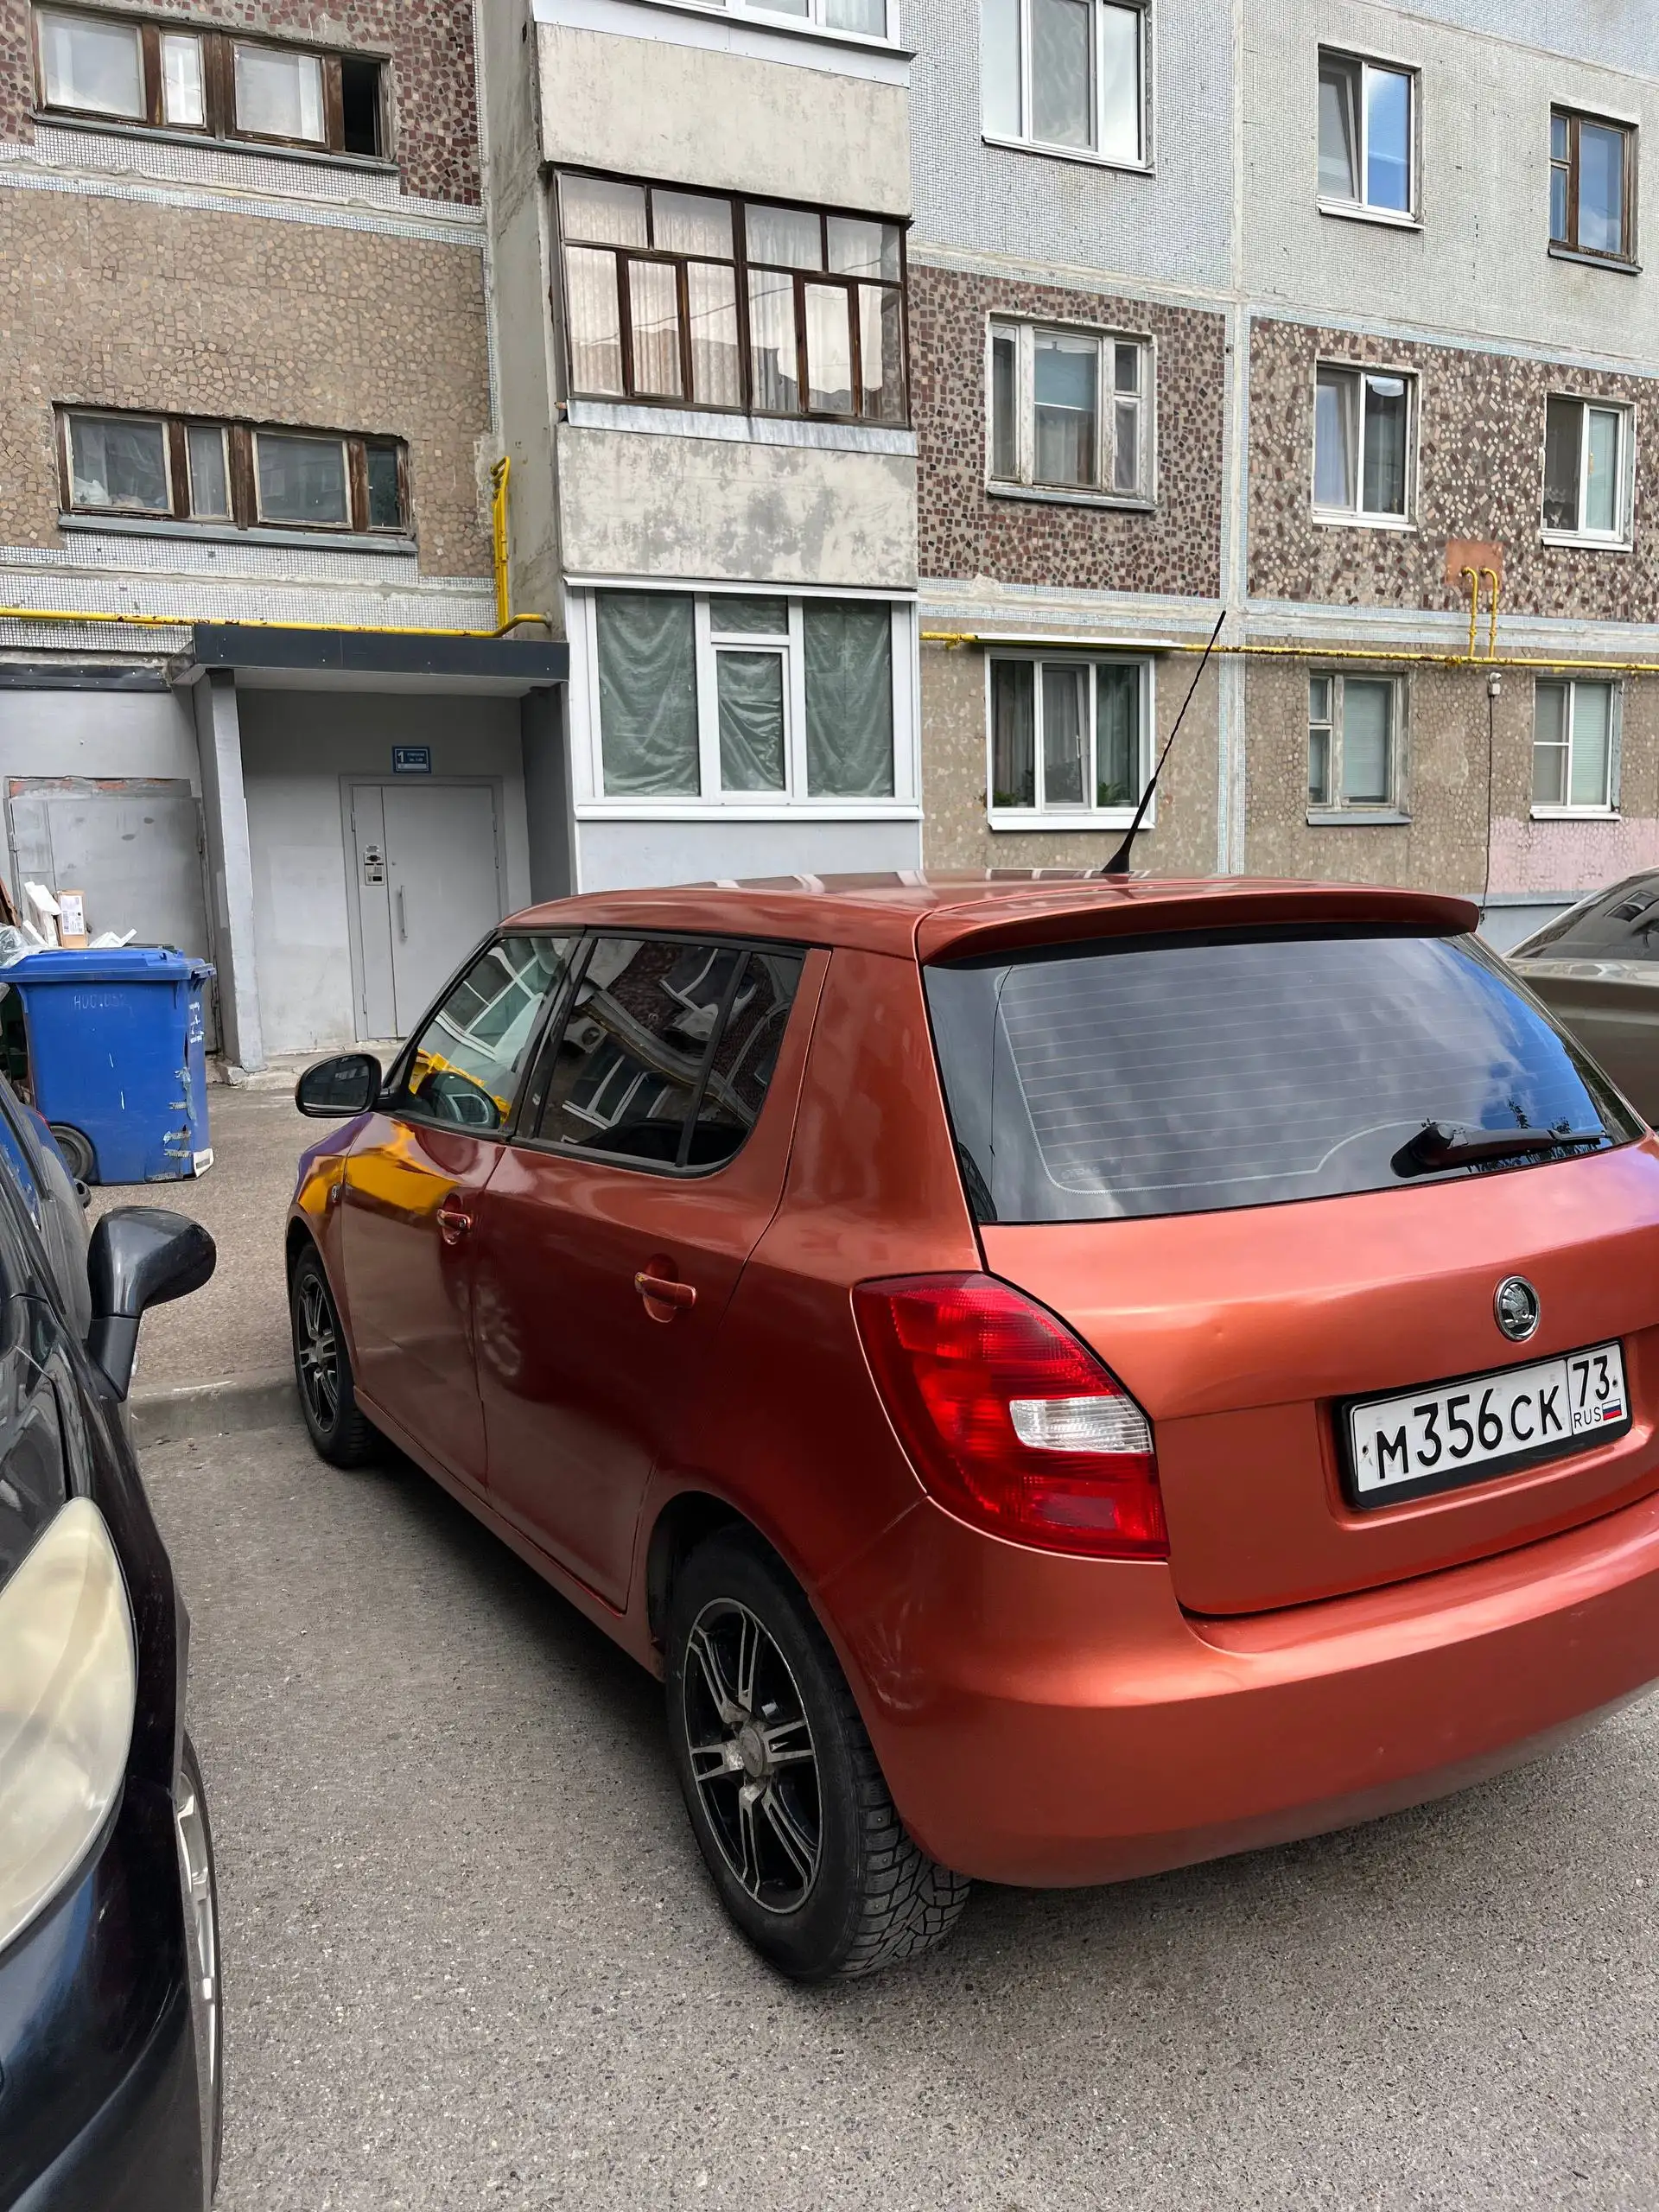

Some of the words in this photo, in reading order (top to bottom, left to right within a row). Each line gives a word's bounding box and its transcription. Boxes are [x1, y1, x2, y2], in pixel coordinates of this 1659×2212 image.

[397, 751, 404, 763] 1
[1376, 1385, 1563, 1479] М356СК
[1572, 1355, 1610, 1408] 73
[1573, 1408, 1601, 1429] RUS
